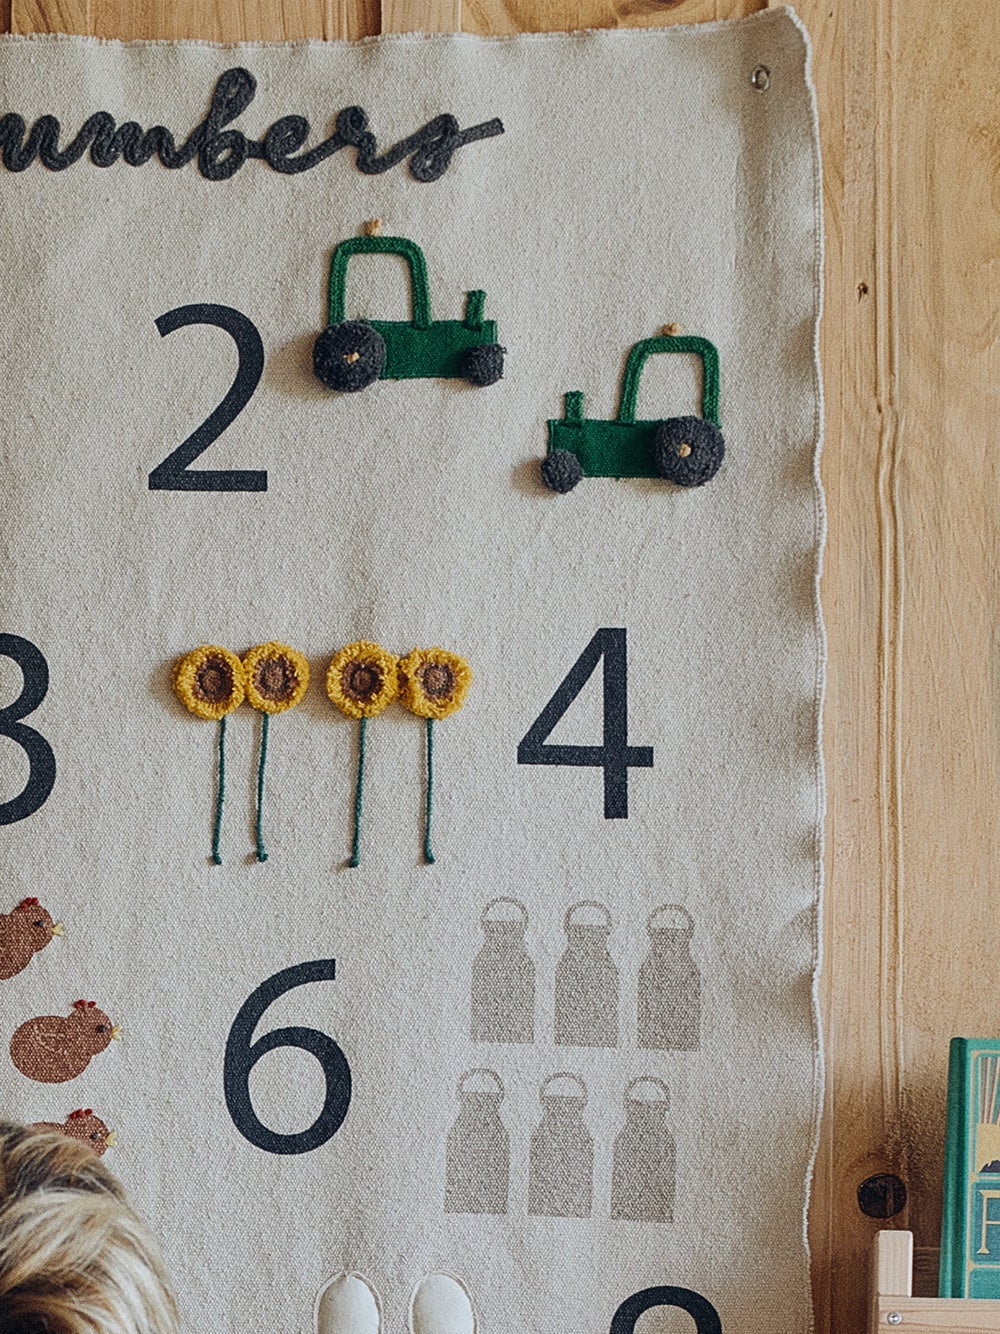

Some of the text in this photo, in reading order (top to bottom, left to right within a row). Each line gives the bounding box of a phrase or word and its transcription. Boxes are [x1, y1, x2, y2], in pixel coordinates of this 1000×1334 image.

[148, 303, 269, 492] 2
[516, 627, 655, 820] 4
[222, 958, 352, 1156] 6
